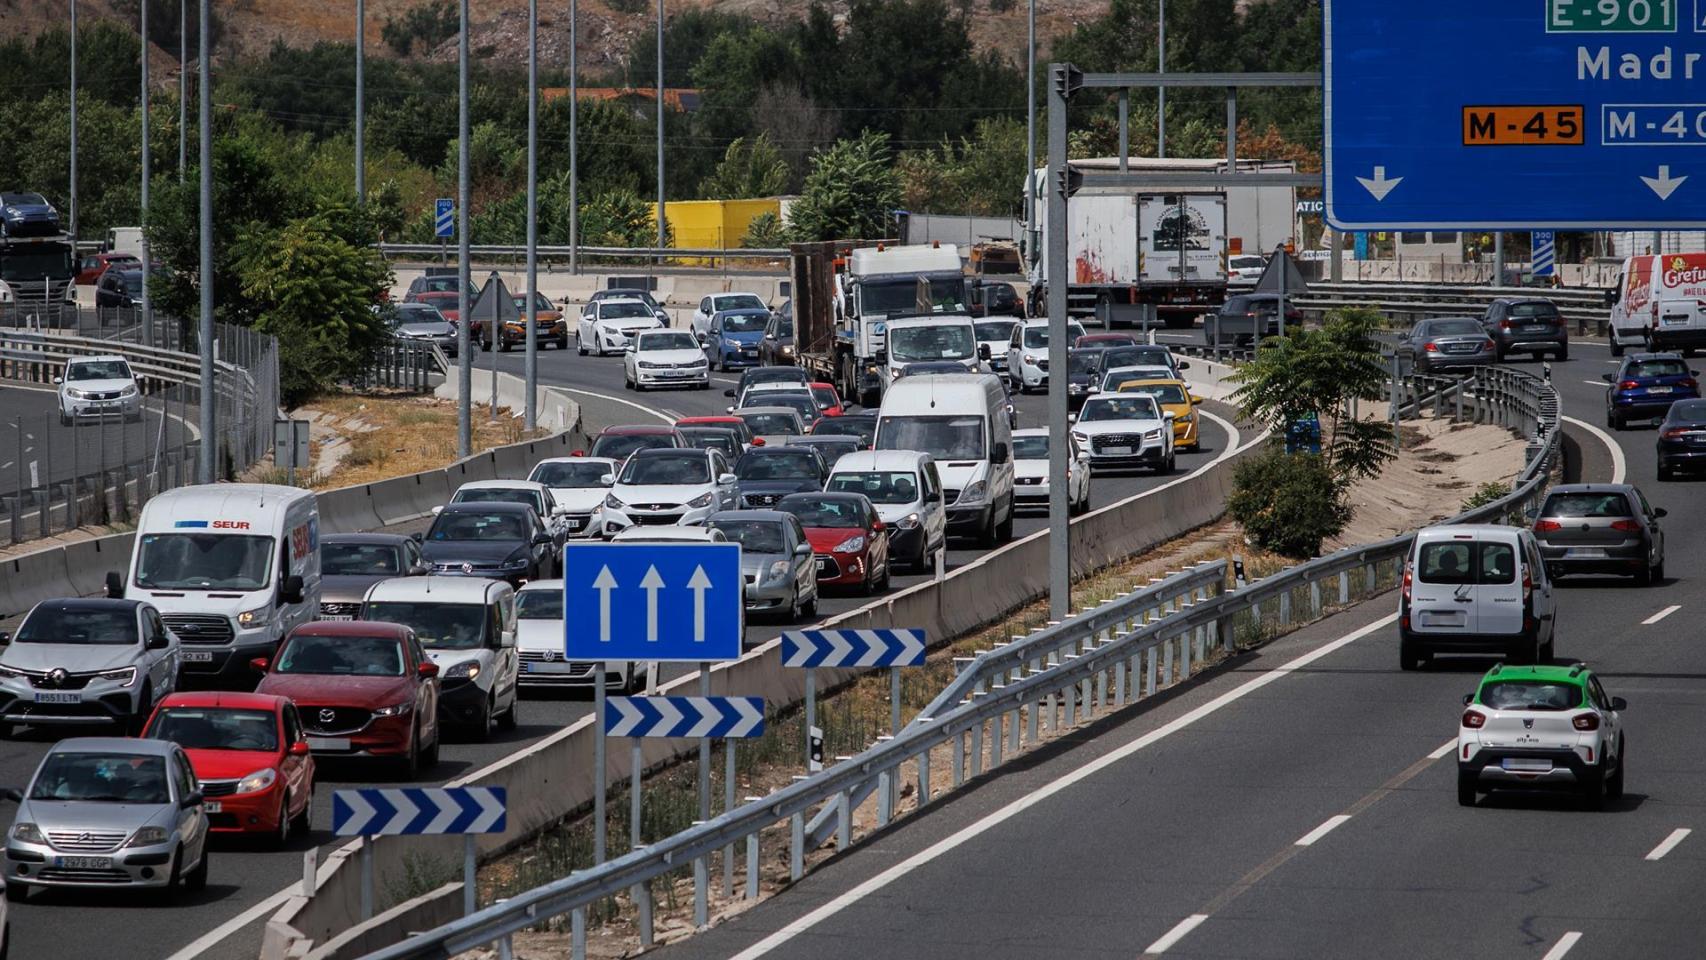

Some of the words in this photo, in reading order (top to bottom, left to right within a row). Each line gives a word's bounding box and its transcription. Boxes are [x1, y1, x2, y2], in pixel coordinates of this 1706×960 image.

[1553, 0, 1671, 26] E-901
[1577, 46, 1701, 80] Madr
[1470, 112, 1577, 139] M-45
[1664, 266, 1706, 287] Grefu
[212, 520, 250, 529] SEUR
